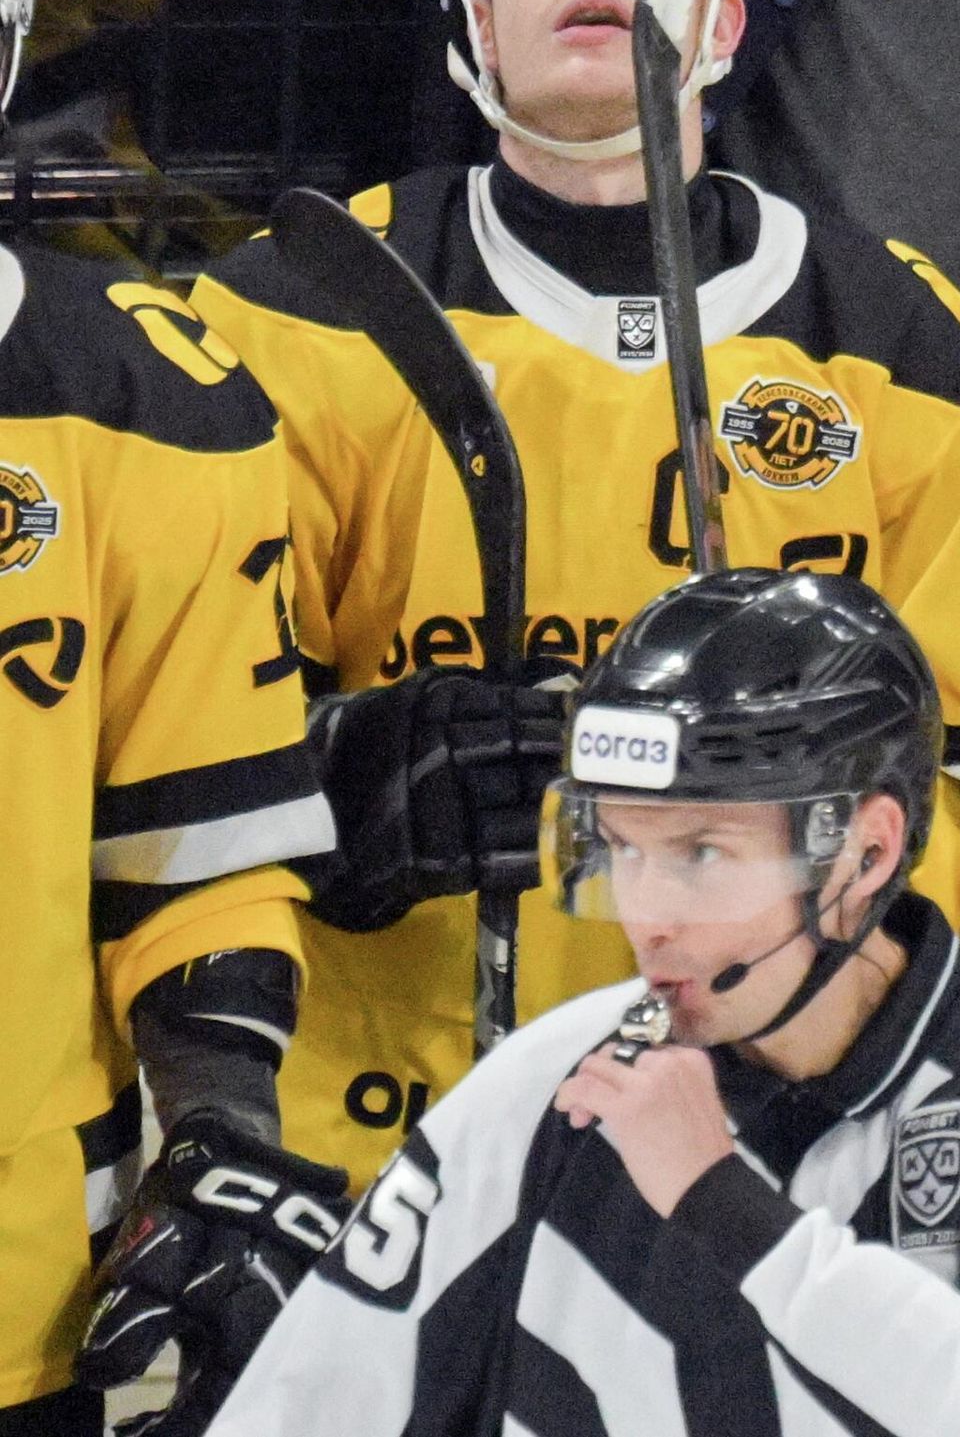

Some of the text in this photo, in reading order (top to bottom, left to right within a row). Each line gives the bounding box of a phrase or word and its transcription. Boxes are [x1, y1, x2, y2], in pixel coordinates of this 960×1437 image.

[765, 411, 815, 455] 70
[769, 453, 798, 467] ЛЕТ
[577, 731, 669, 764] согаз
[192, 1166, 339, 1254] CC
